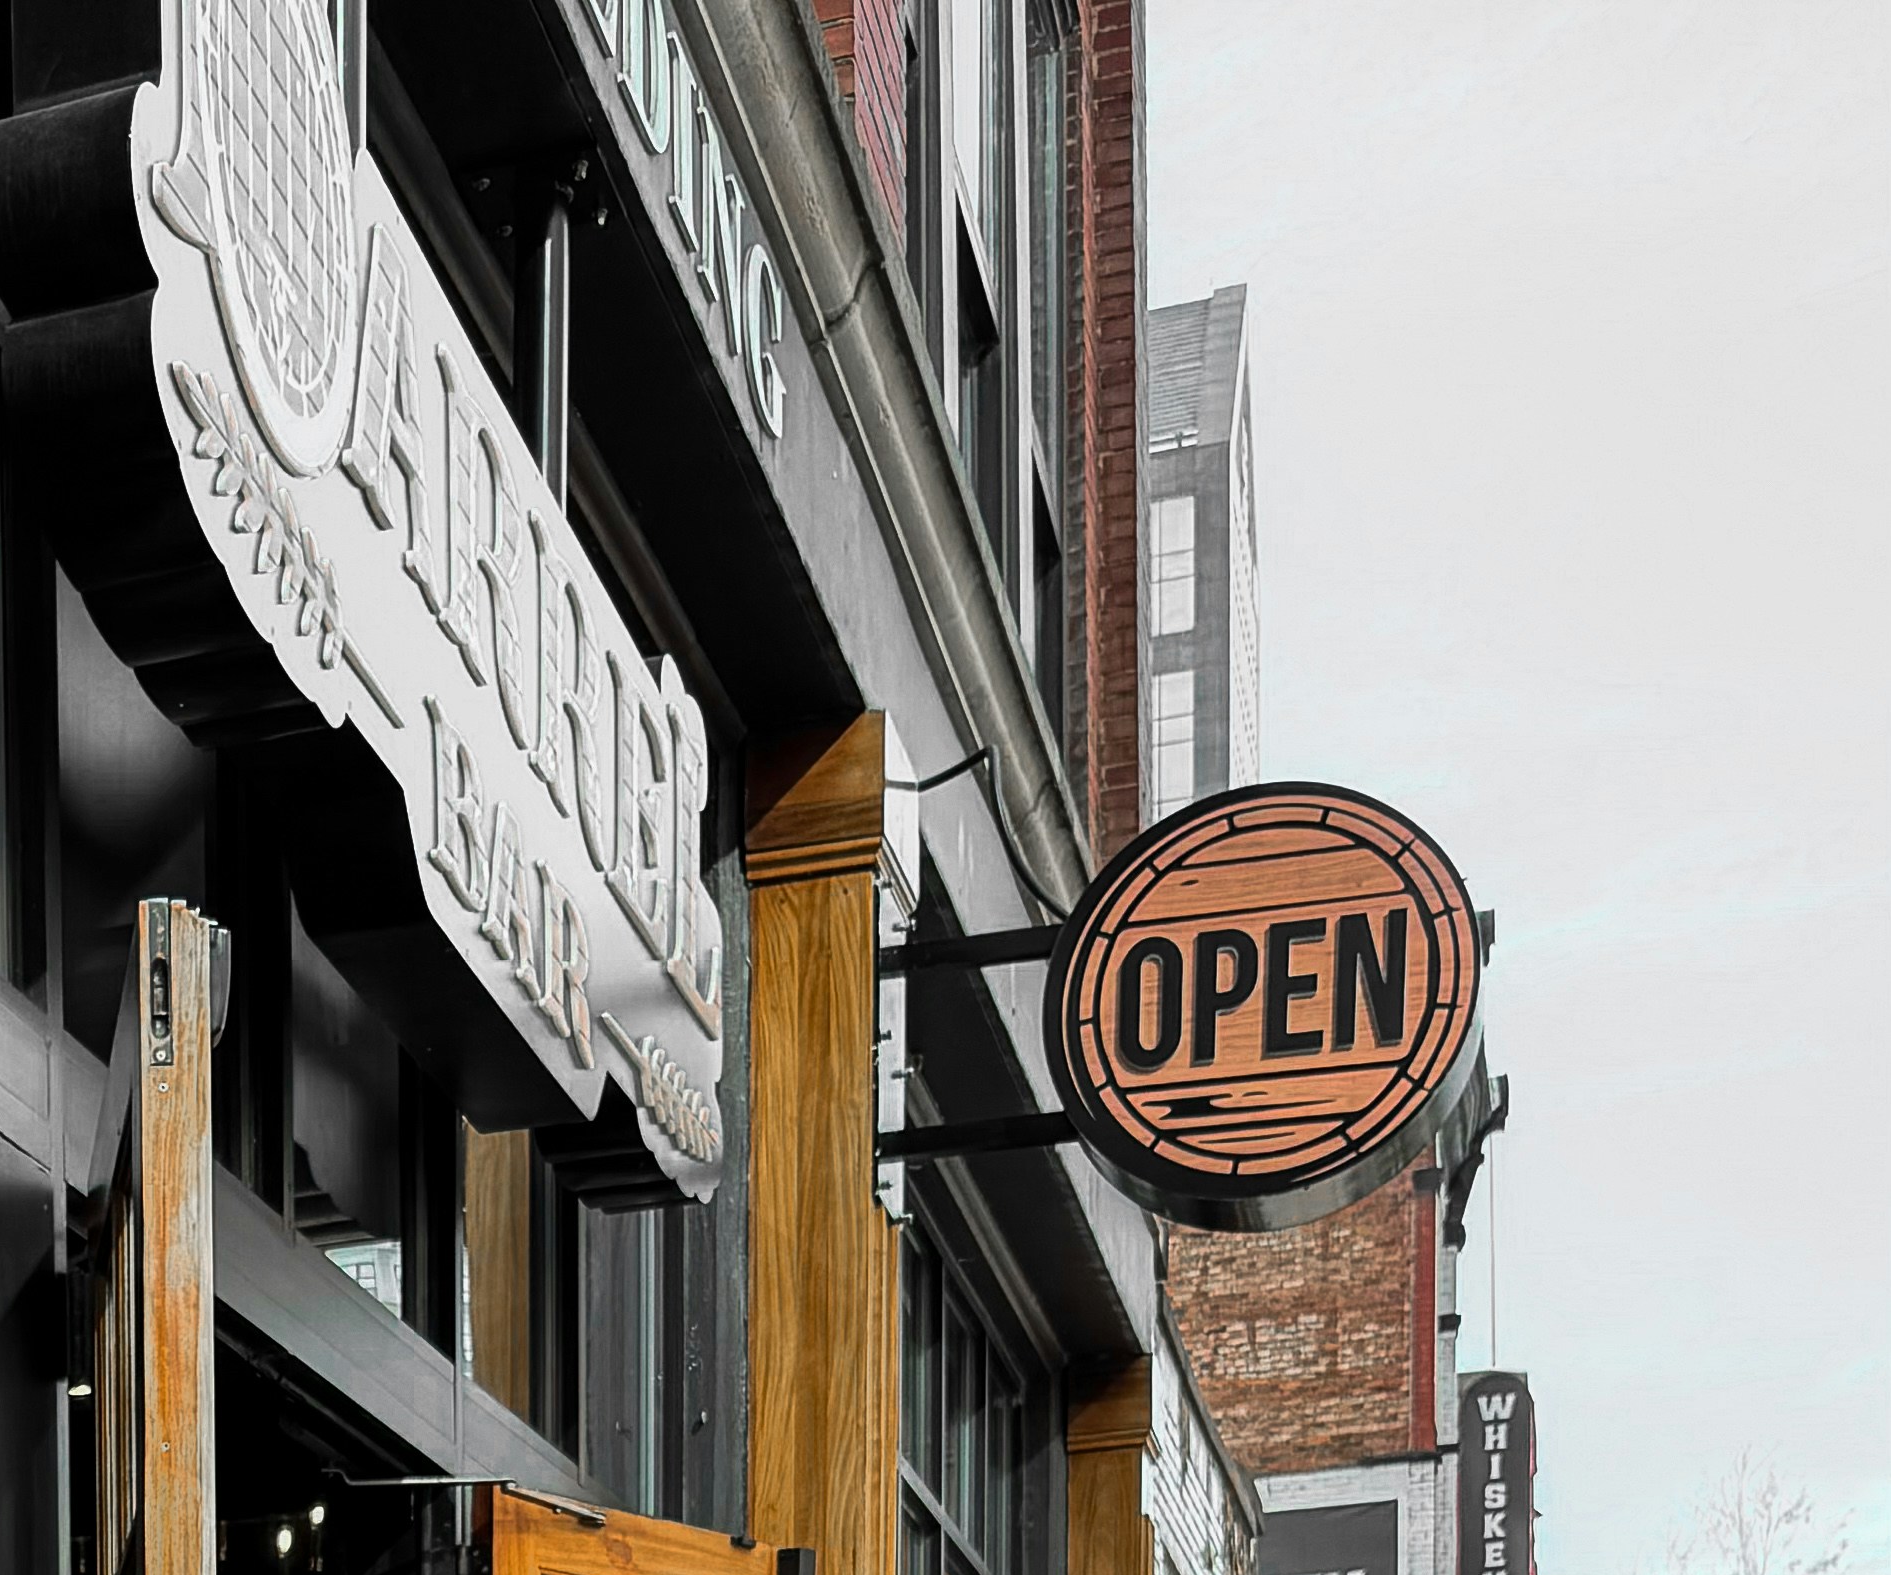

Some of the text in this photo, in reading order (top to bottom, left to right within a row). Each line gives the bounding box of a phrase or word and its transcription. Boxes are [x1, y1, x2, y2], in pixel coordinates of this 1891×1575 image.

[590, 0, 787, 438] DING
[423, 694, 595, 1069] BAR
[1115, 906, 1409, 1075] OPEN
